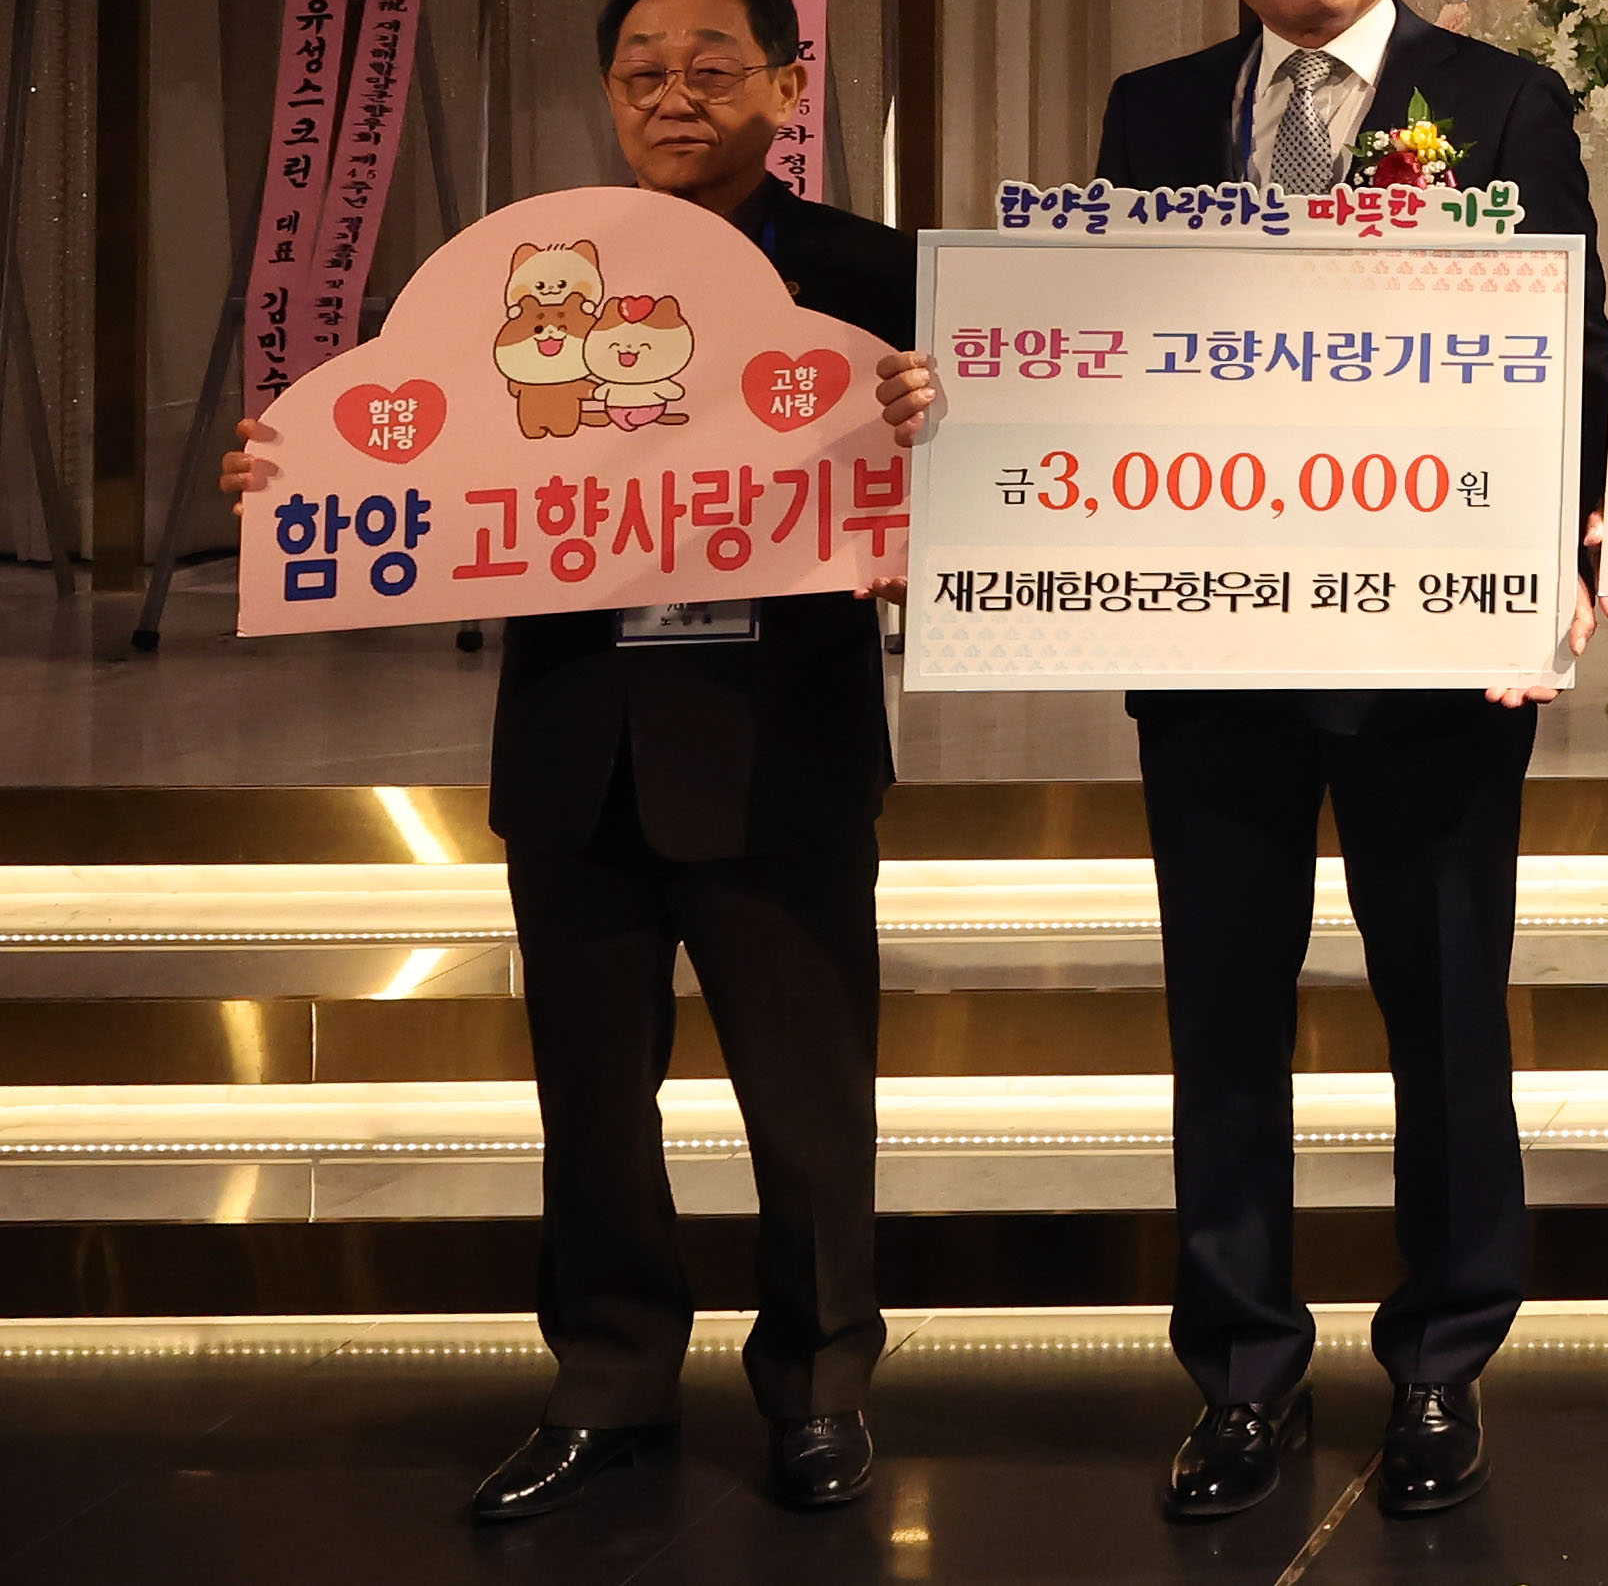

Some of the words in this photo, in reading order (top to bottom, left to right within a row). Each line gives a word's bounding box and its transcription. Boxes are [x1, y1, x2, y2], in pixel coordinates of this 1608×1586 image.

[1000, 178, 1111, 234] 함양을
[1128, 184, 1290, 235] 사랑하는
[1307, 186, 1426, 238] 따뜻한
[1441, 181, 1516, 235] 기부
[269, 211, 300, 264] 대표
[771, 365, 818, 392] 고향
[951, 327, 1127, 381] 함양군
[1145, 330, 1553, 384] 고향사랑기부금
[368, 397, 418, 423] 함양
[771, 392, 817, 419] 사랑
[367, 424, 417, 450] 사랑
[275, 487, 431, 602] 함양
[452, 456, 911, 582] 고향사랑기부
[933, 570, 1291, 615] 재김해함양군향우회
[1311, 571, 1395, 615] 회장
[1418, 571, 1540, 616] 양재민
